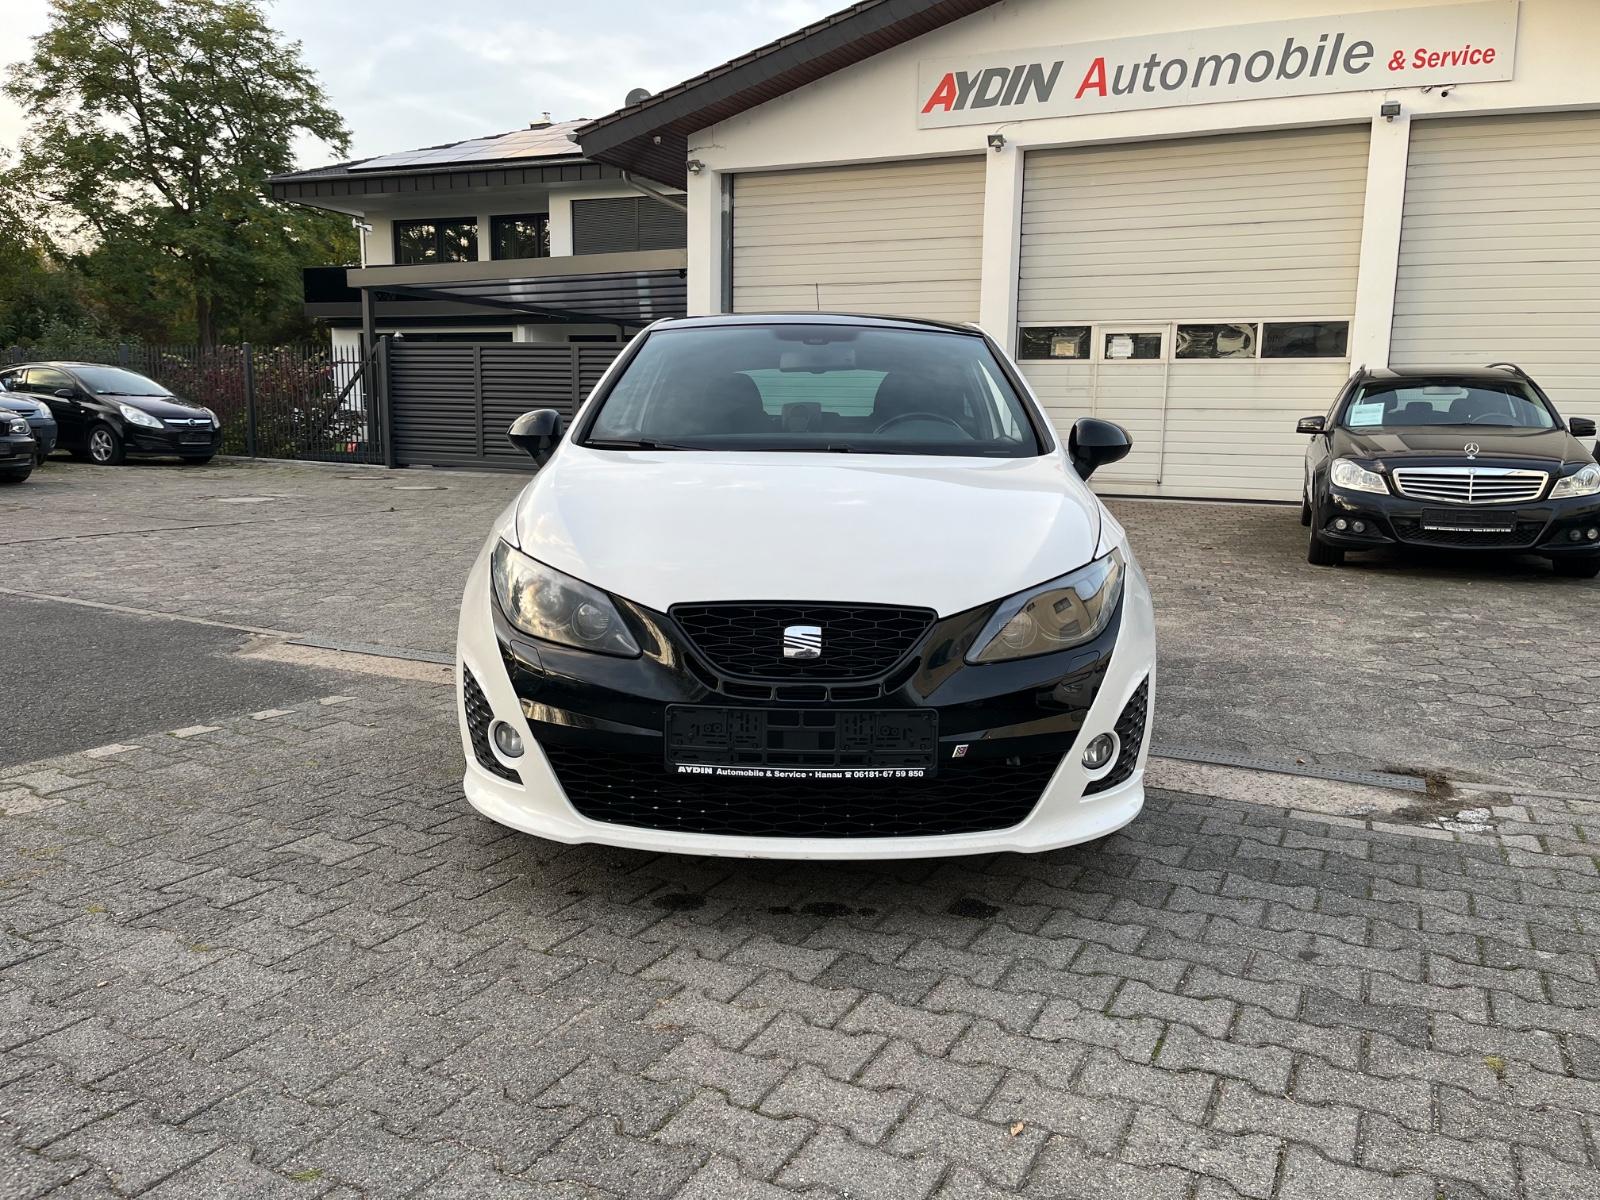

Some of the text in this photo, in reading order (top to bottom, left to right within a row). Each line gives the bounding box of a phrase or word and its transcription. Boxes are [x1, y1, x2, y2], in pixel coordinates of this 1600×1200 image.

[921, 33, 1496, 113] AYDIN Automobile & Service
[677, 766, 713, 774] AYDIN
[716, 768, 764, 777] Automobile
[774, 770, 807, 778] Service
[853, 770, 894, 778] 06181-67
[895, 770, 906, 778] 59
